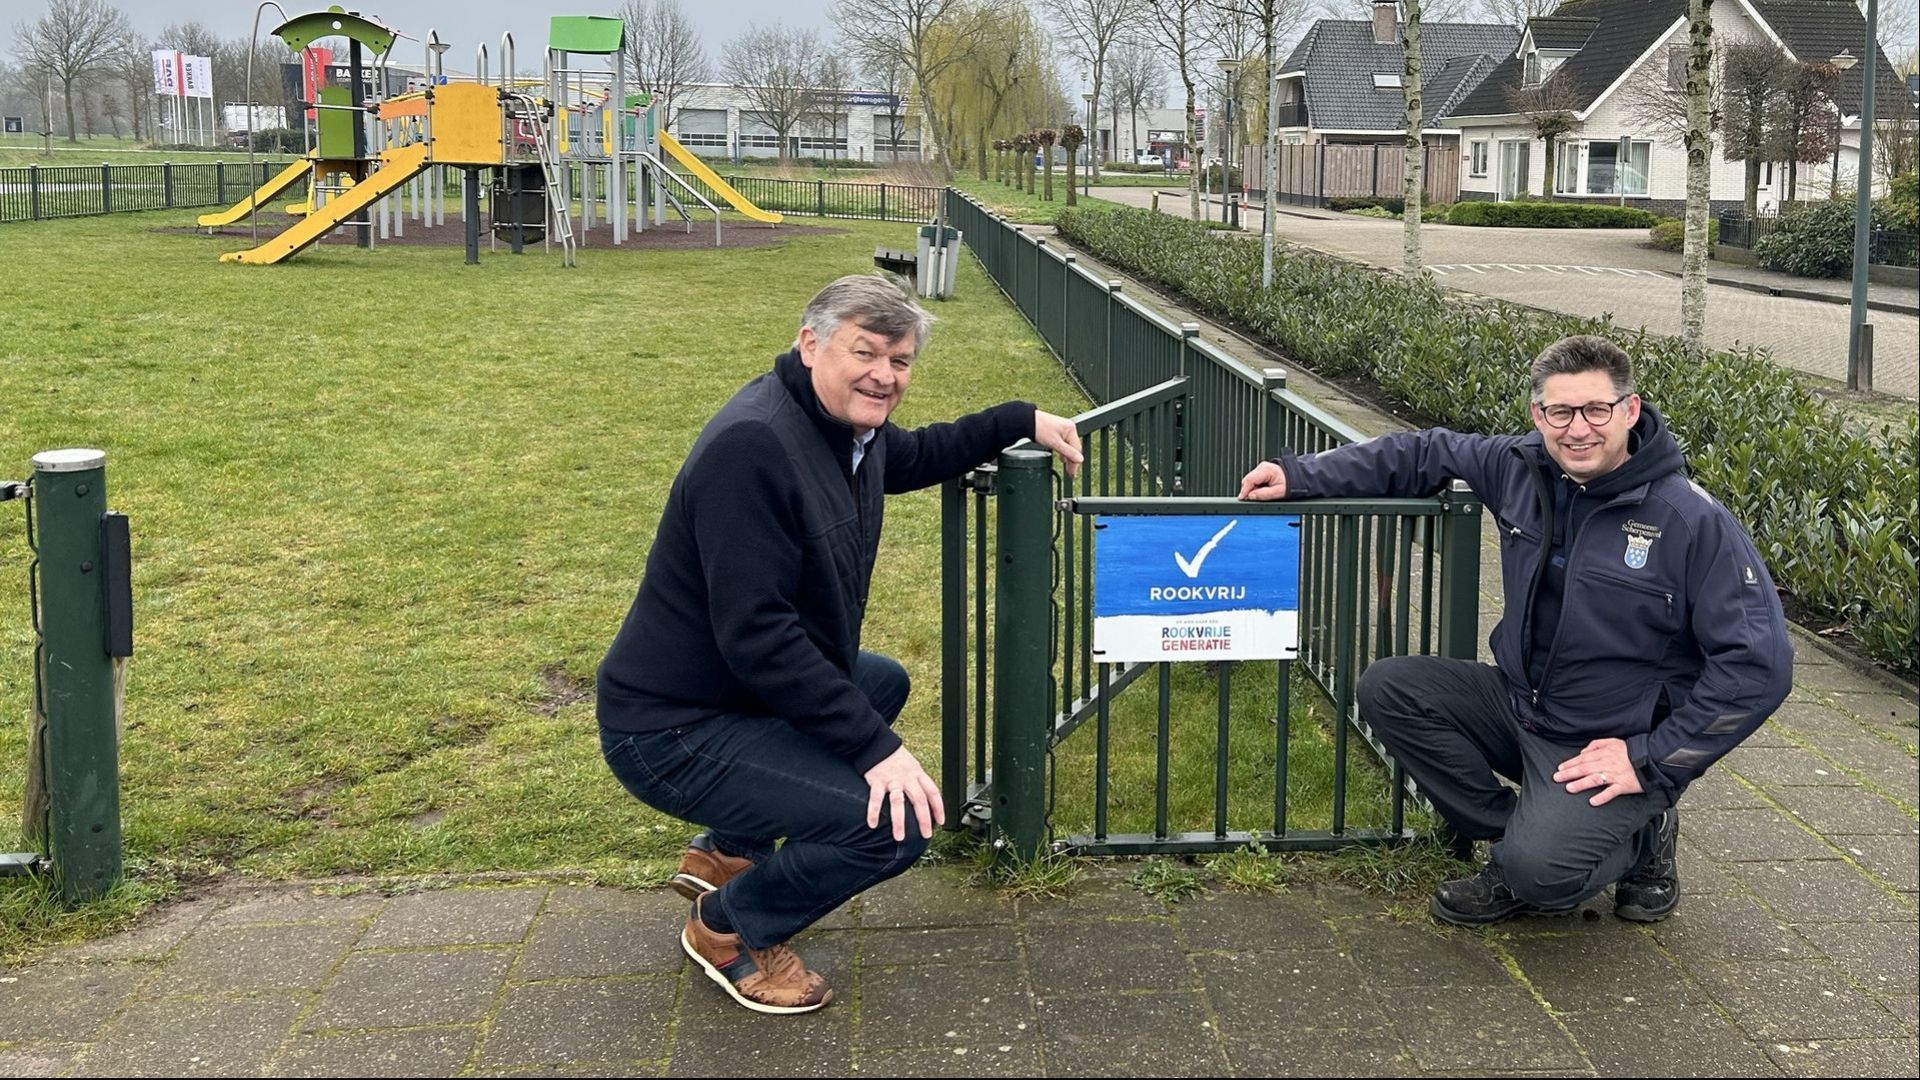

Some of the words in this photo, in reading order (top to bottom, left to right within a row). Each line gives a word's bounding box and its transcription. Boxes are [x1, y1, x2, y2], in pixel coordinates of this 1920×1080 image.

[1150, 586, 1246, 601] ROOKVRIJ
[1162, 626, 1231, 638] ROOKVRIJE
[1162, 639, 1231, 651] GENERATIE
